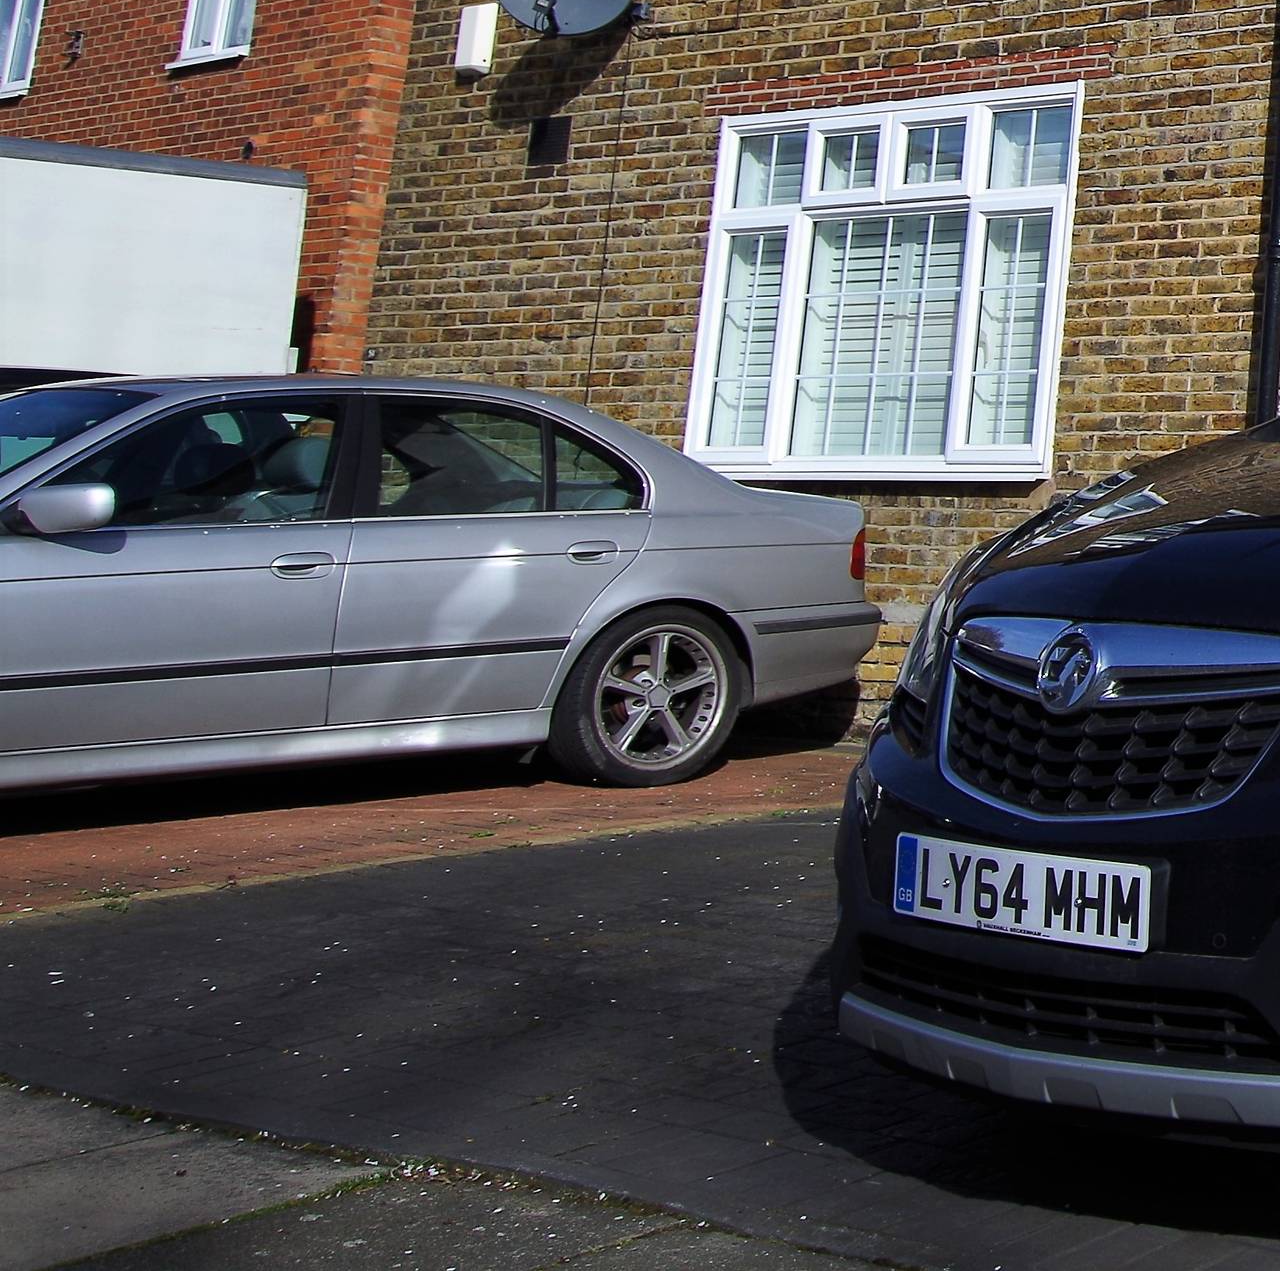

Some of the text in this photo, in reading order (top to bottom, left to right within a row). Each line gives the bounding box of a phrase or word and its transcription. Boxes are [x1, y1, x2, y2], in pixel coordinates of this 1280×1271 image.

[898, 887, 913, 902] GB
[919, 847, 1142, 941] LY64 MHM
